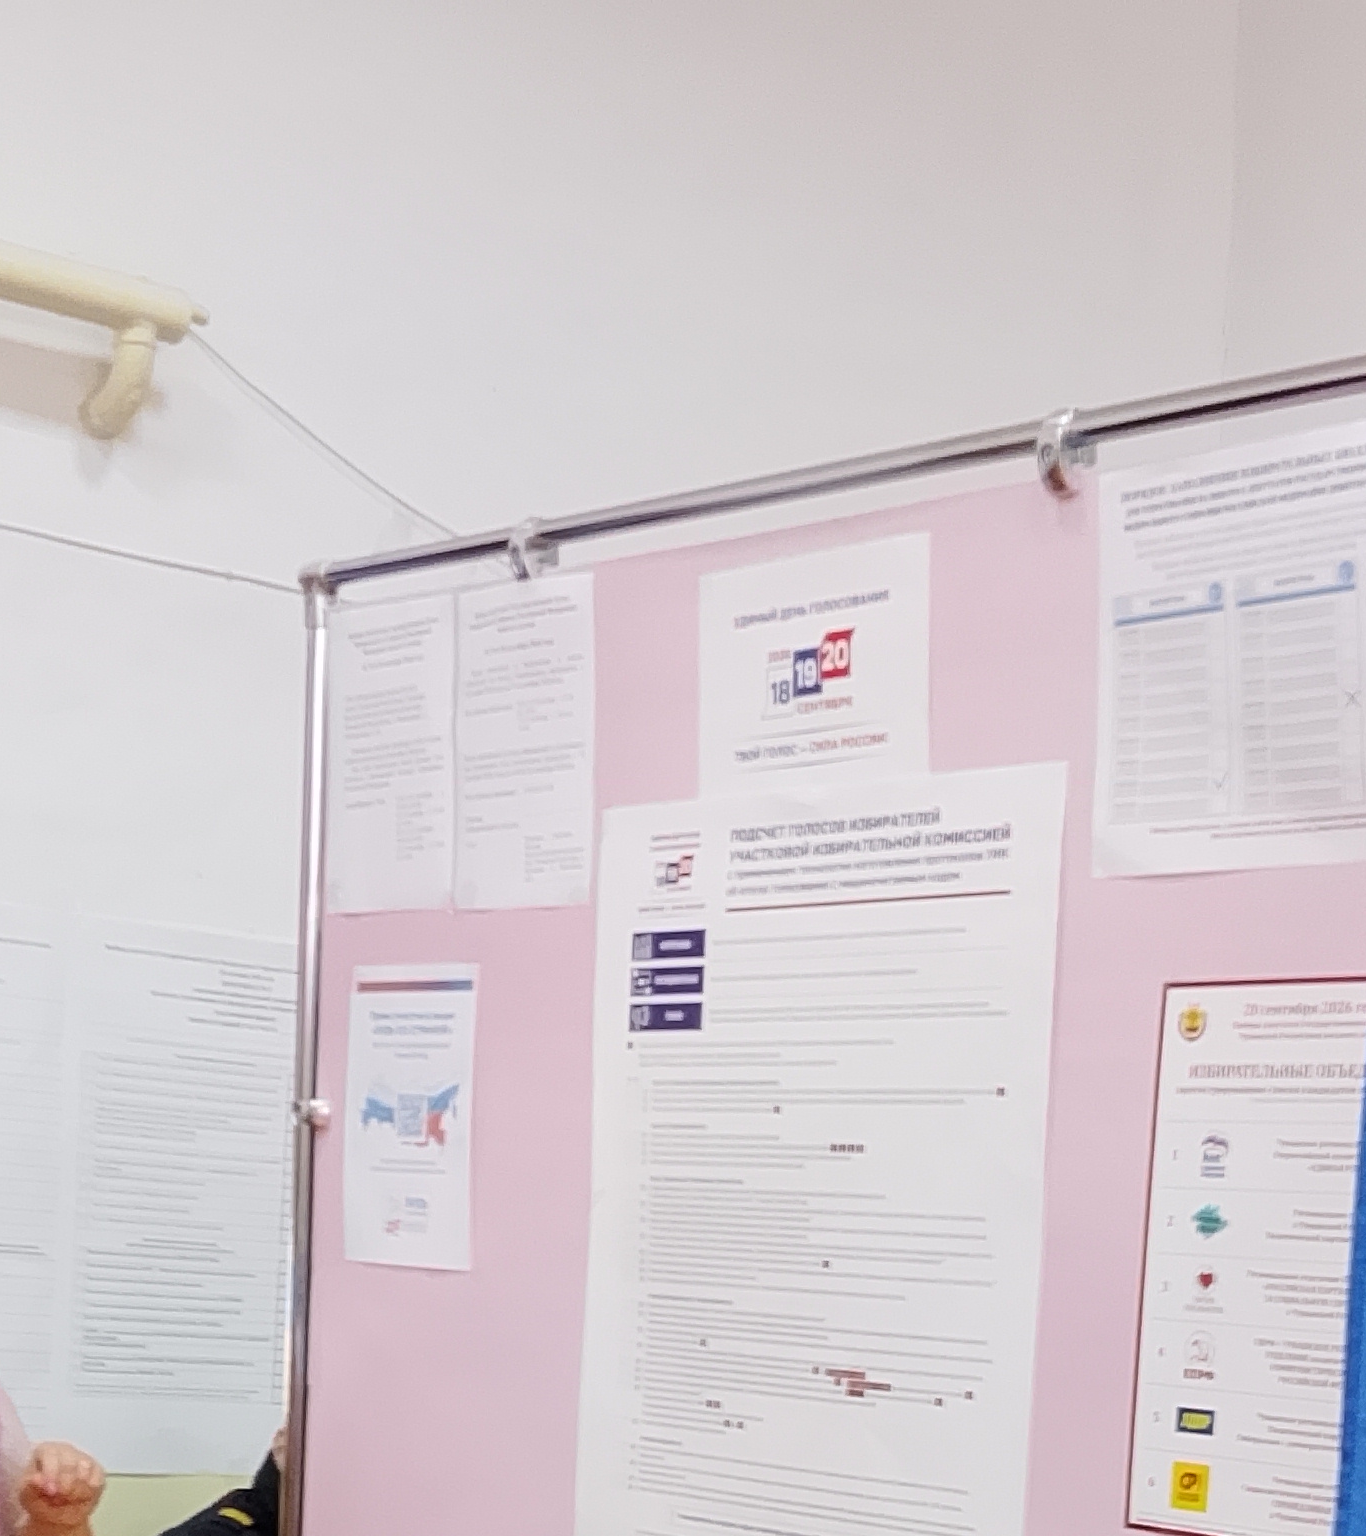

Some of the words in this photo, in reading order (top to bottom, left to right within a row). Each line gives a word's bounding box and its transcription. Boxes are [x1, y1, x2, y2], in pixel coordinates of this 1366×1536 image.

[821, 637, 850, 672] 20
[794, 656, 818, 690] 19
[771, 679, 791, 705] 18
[730, 825, 786, 842] ПОДСЧЕТ
[848, 807, 940, 832] ИЗБИРАТЕЛЕЙ
[730, 842, 809, 862] УЧАСТКОВОЙ
[812, 831, 921, 856] ИЗБИРАТЕЛЬНОЙ
[924, 823, 1011, 847] КОМИССИЕЙ
[1188, 1064, 1313, 1079] ИЗБИРАТЕЛЬНЫЕ
